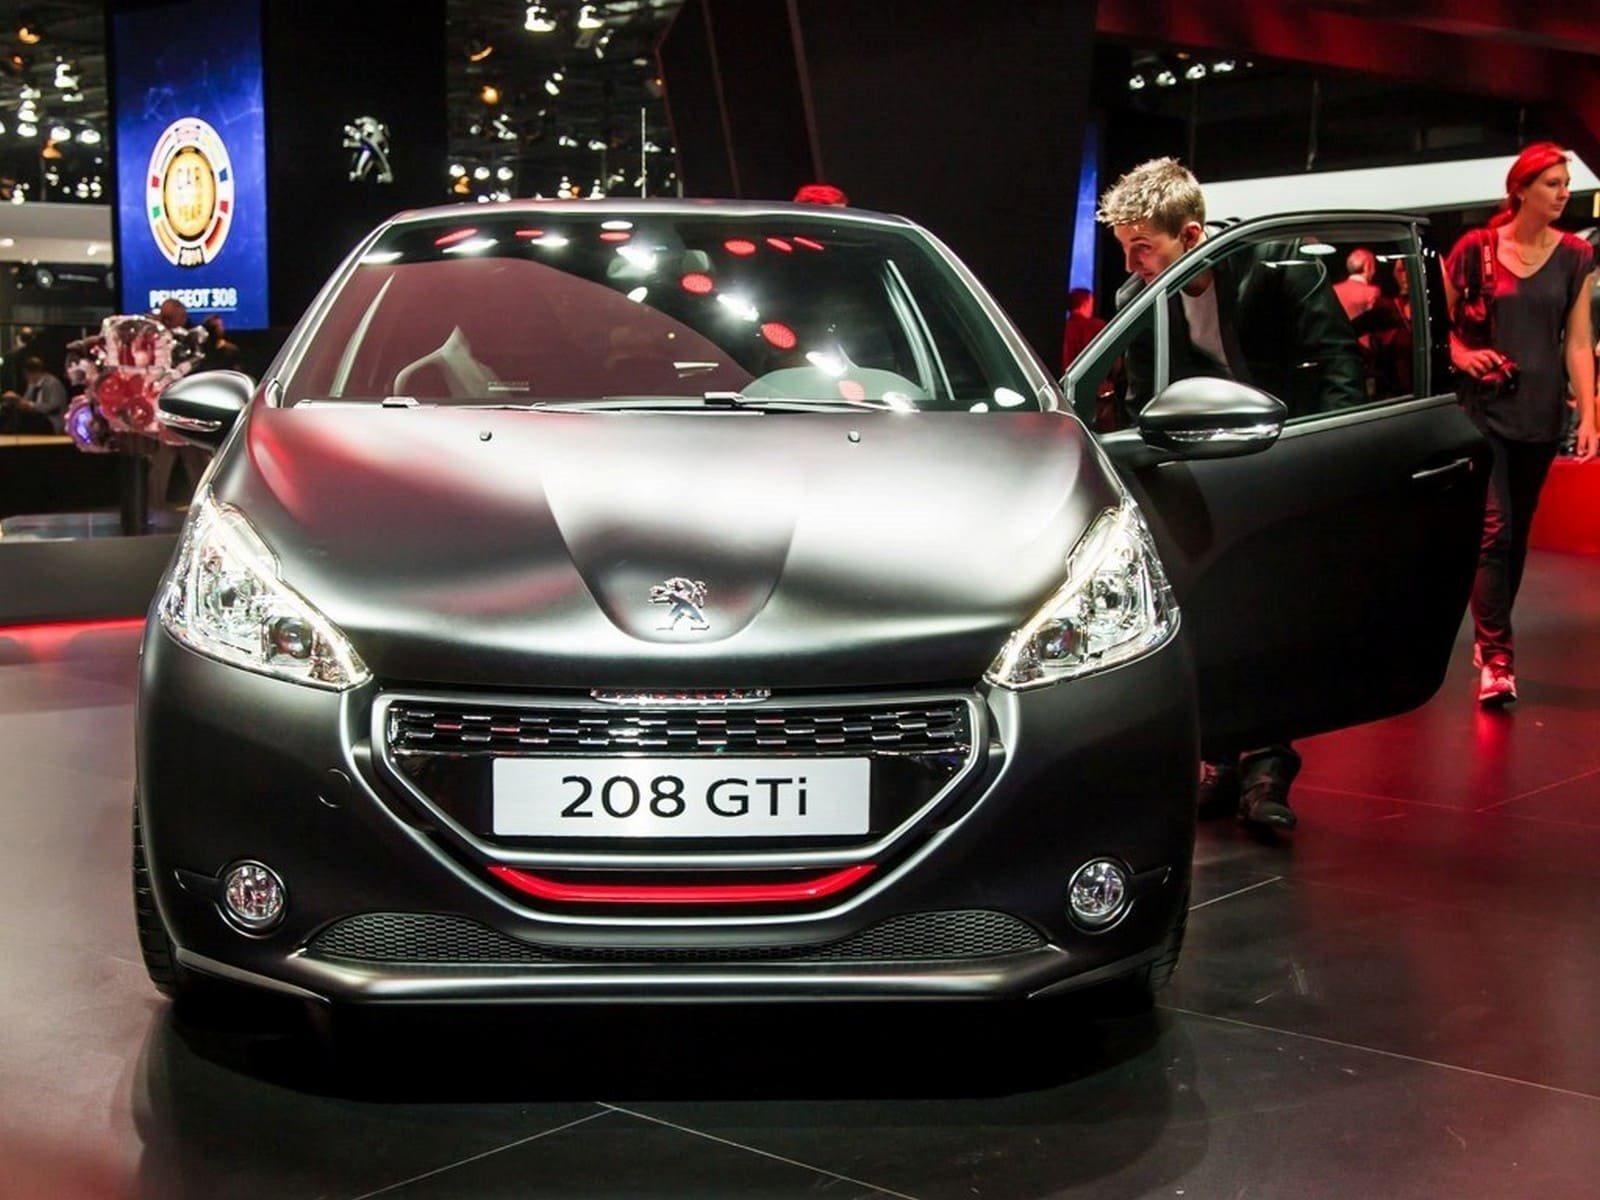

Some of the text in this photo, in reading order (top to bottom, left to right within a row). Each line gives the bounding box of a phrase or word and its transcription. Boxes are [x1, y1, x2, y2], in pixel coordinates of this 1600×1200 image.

[211, 287, 237, 308] 308
[560, 775, 807, 818] 208 GTi
